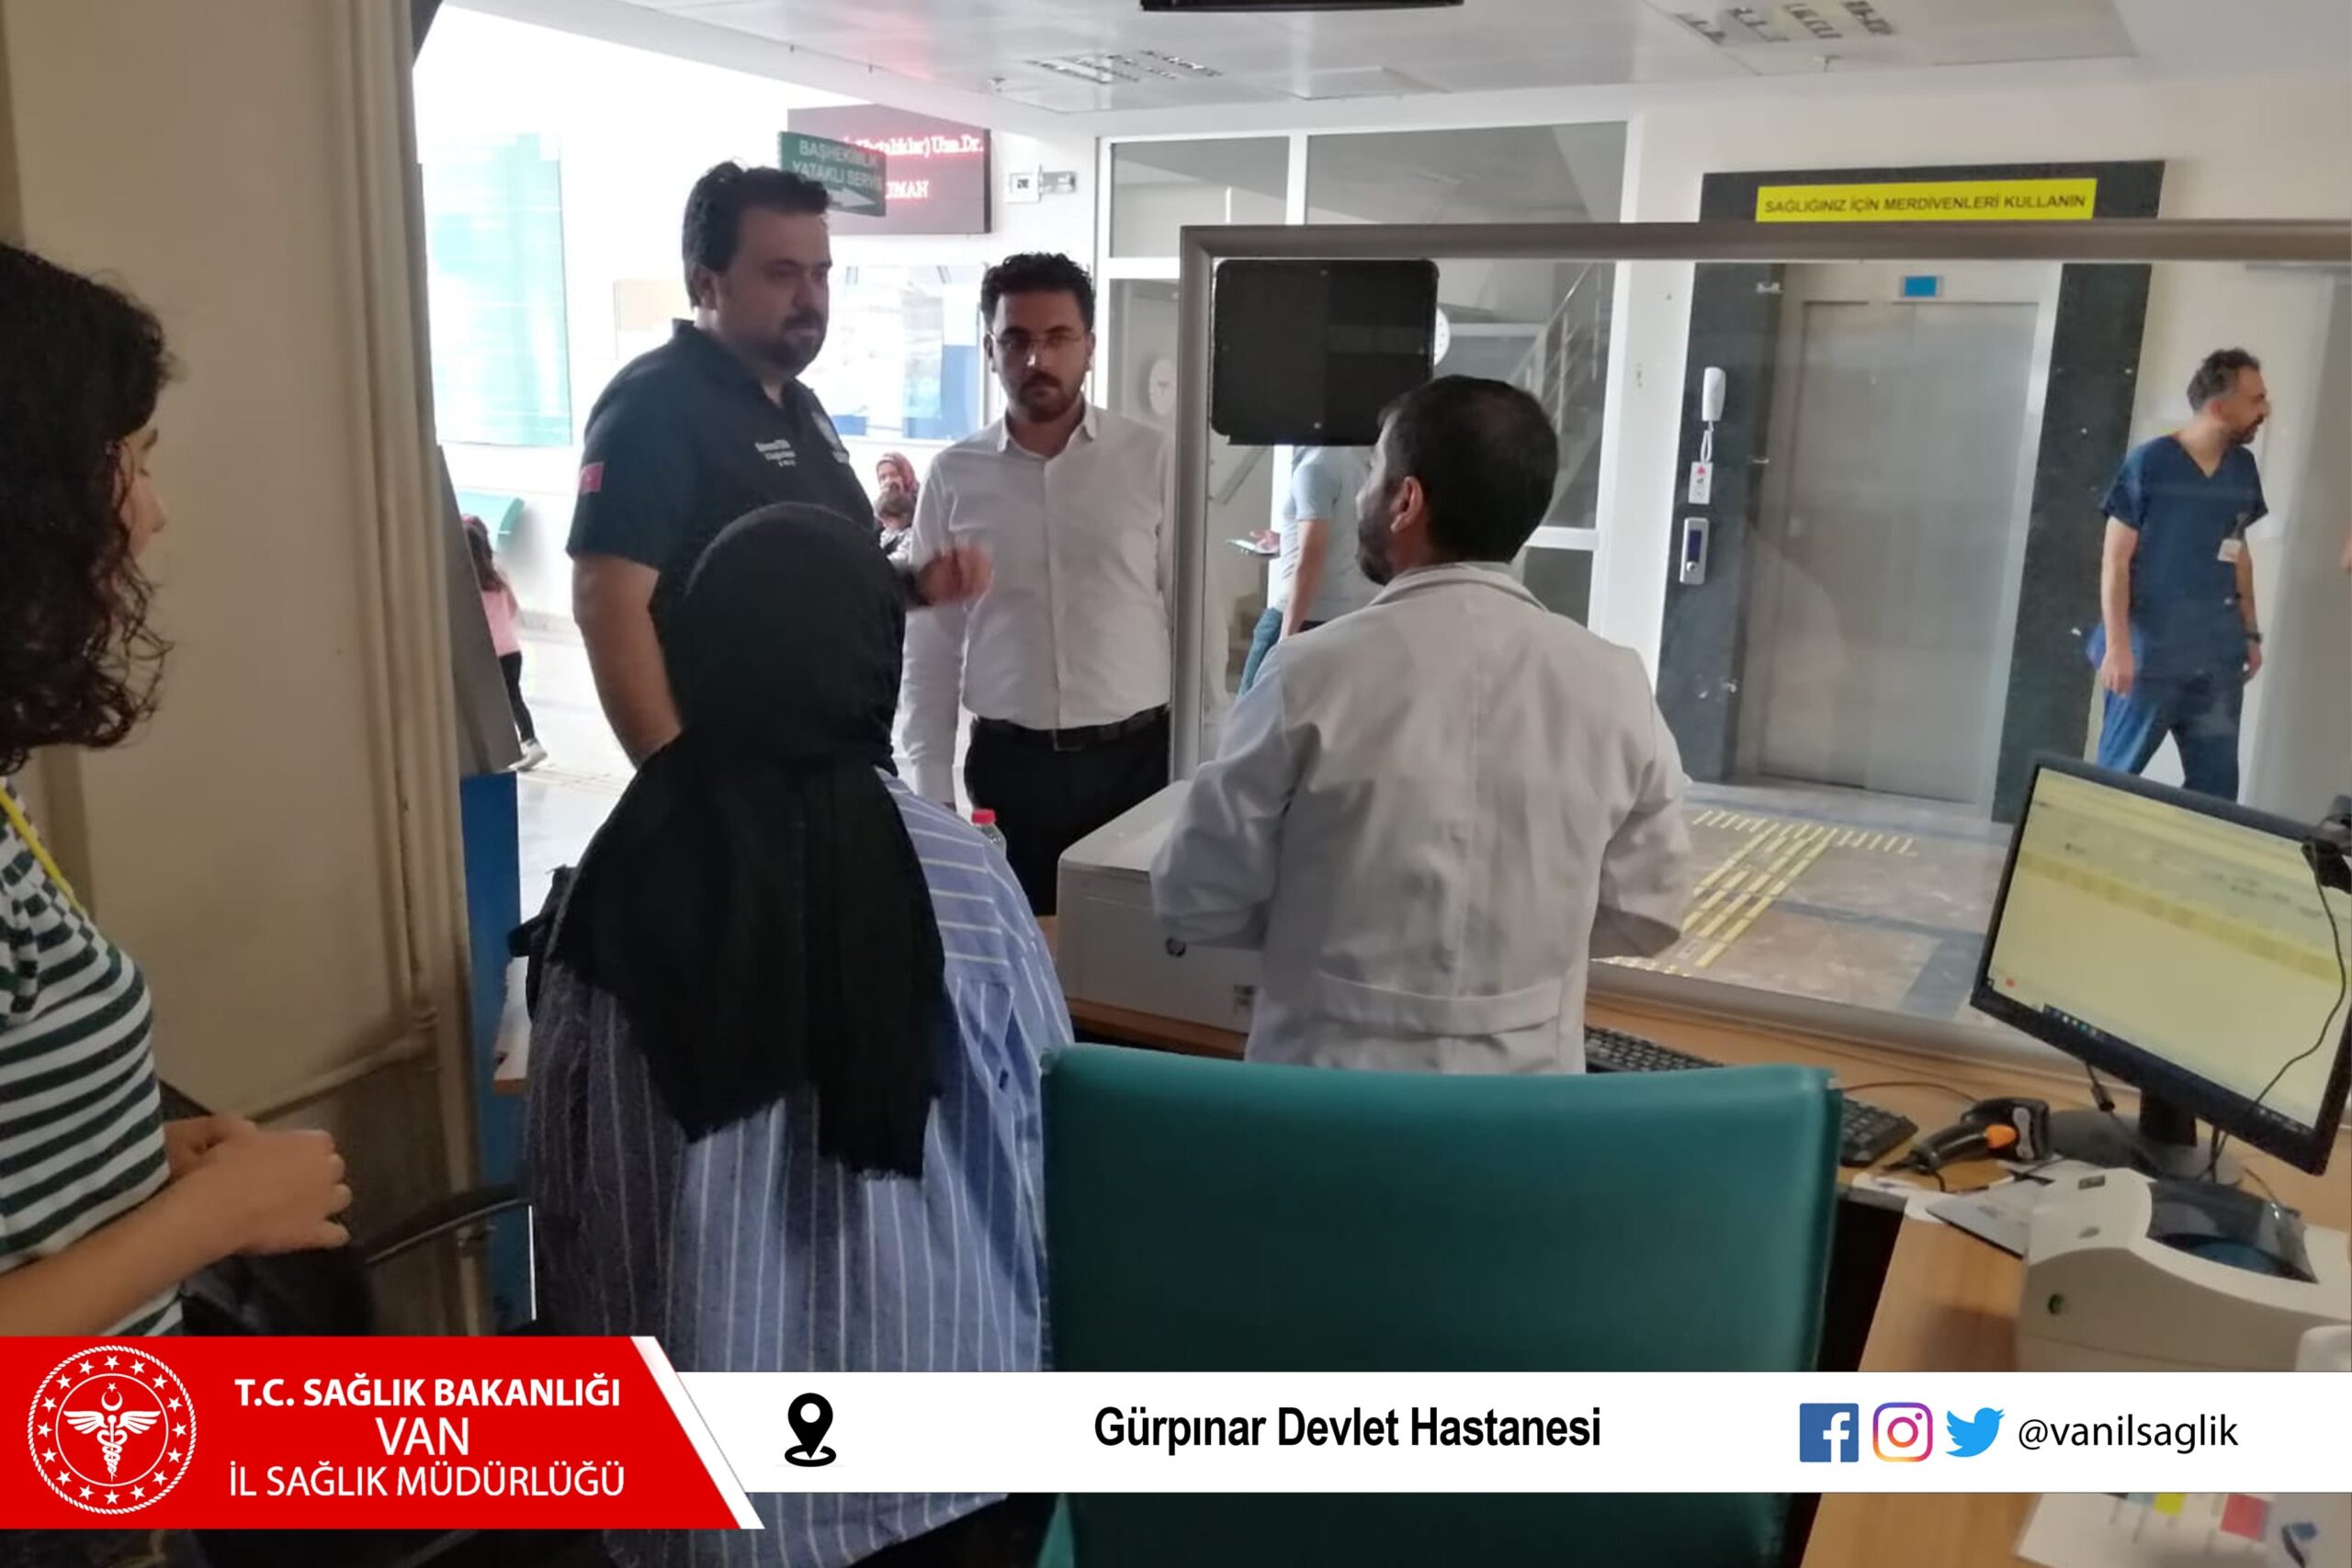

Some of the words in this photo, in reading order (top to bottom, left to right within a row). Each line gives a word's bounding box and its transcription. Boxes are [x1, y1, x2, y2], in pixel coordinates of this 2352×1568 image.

[1764, 197, 1846, 213] SAĞLIĞINIZ
[1850, 196, 1880, 213] İÇİN
[1883, 194, 1999, 211] MERDİVENLERİ
[2004, 194, 2086, 209] KULLANIN
